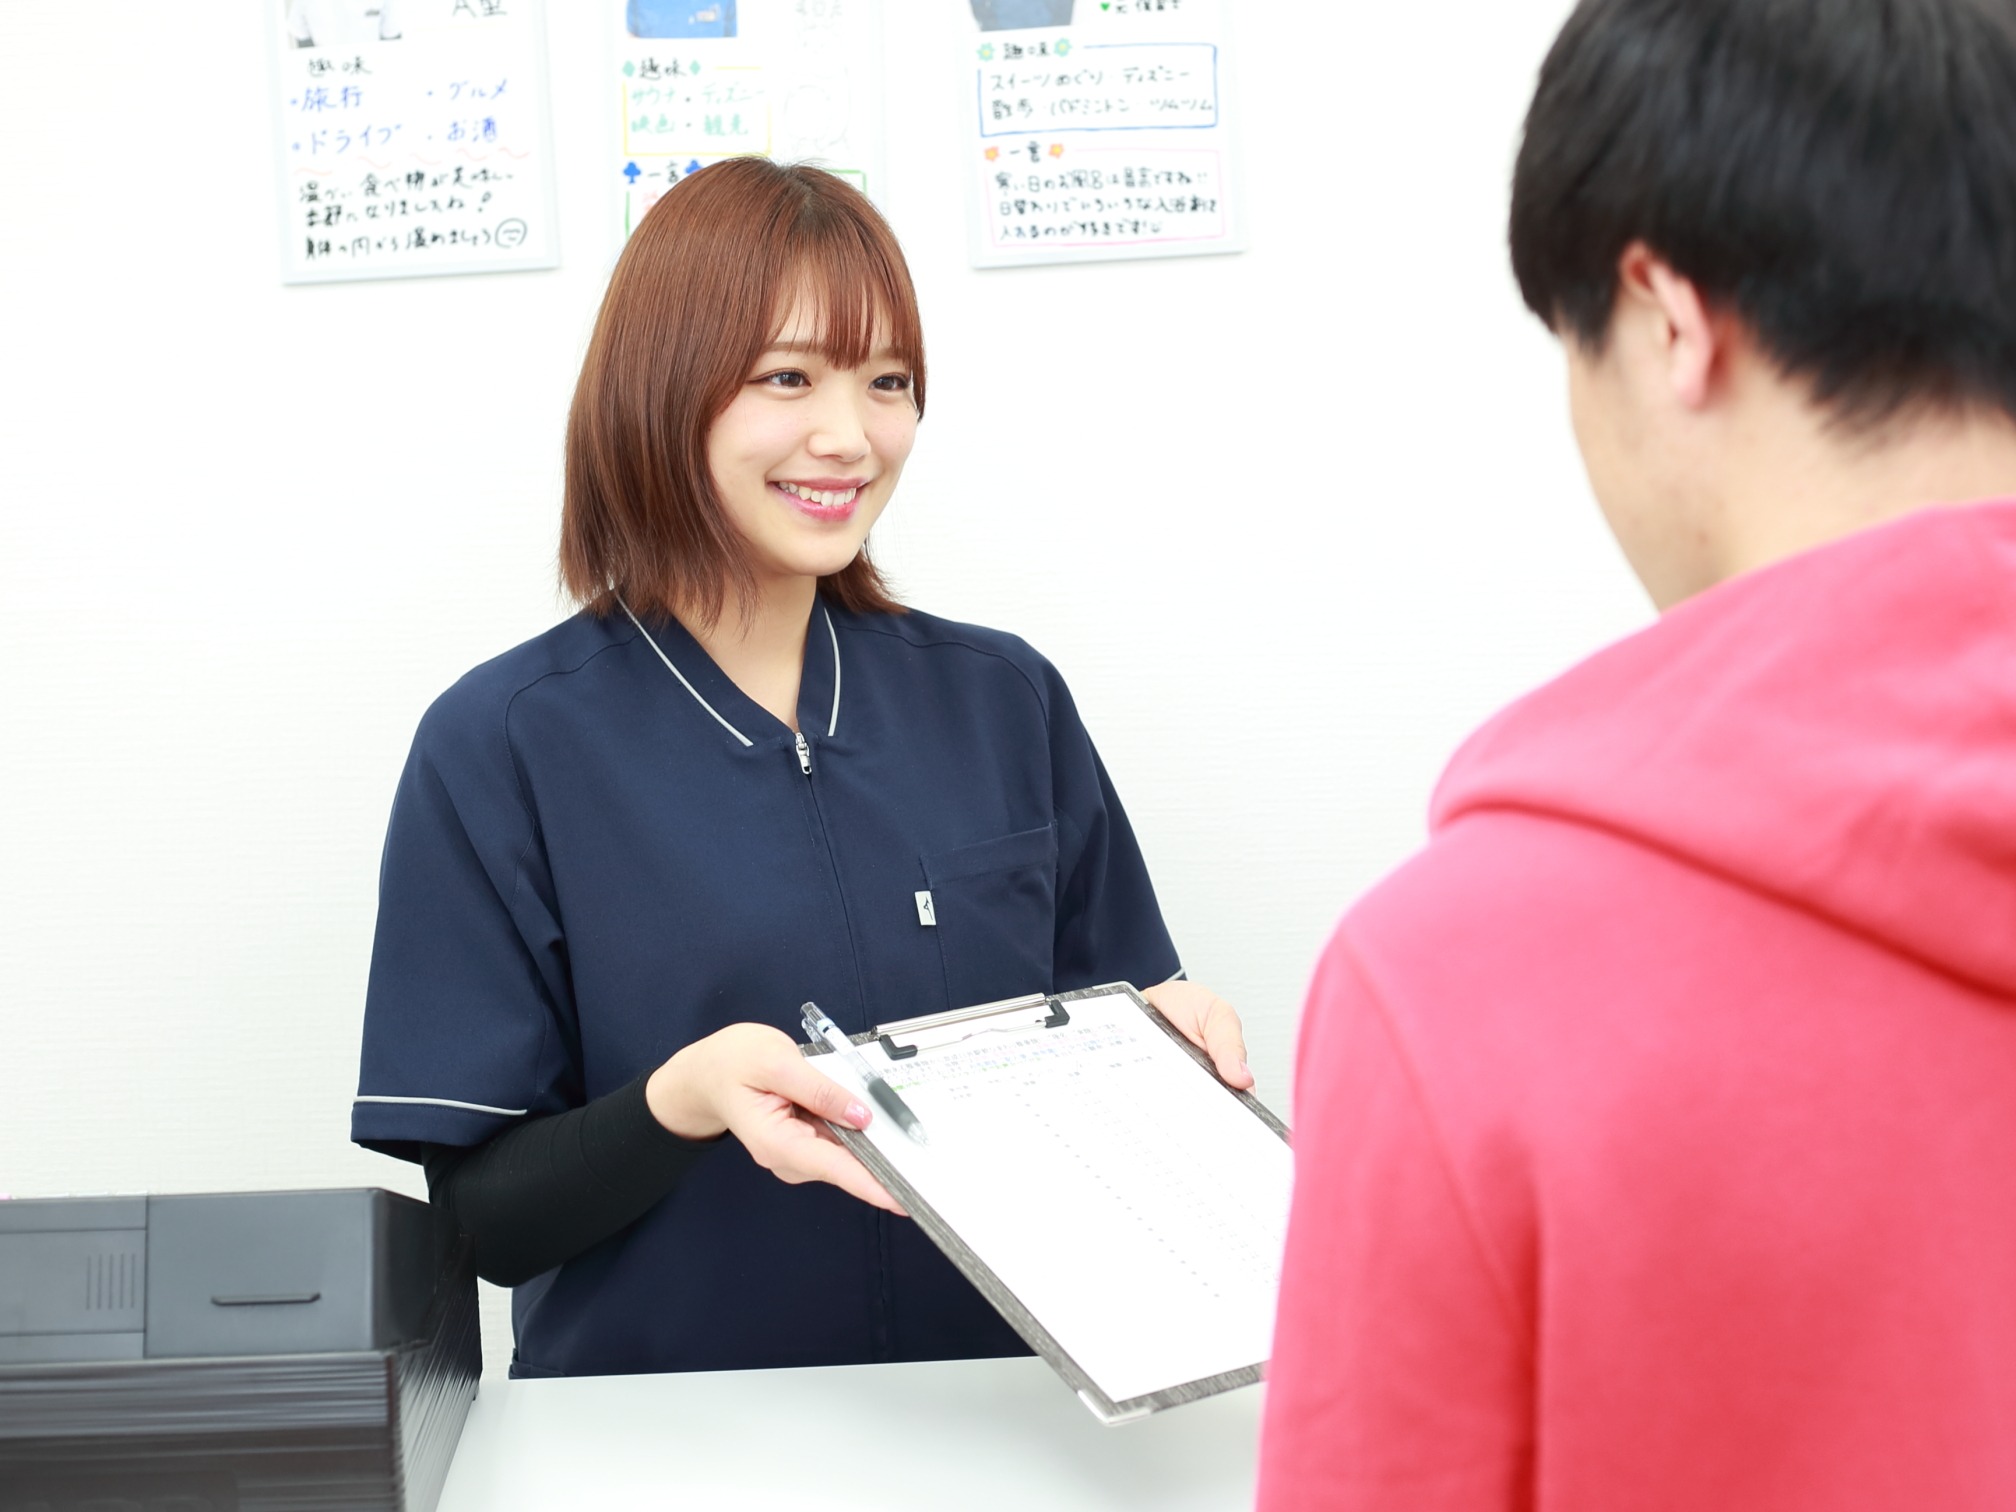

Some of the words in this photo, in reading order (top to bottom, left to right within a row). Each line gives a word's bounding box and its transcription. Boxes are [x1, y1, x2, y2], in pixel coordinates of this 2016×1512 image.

[1002, 42, 1050, 60] 趣味
[306, 55, 373, 78] 趣味
[639, 57, 687, 81] 趣味
[1009, 141, 1042, 163] 一言
